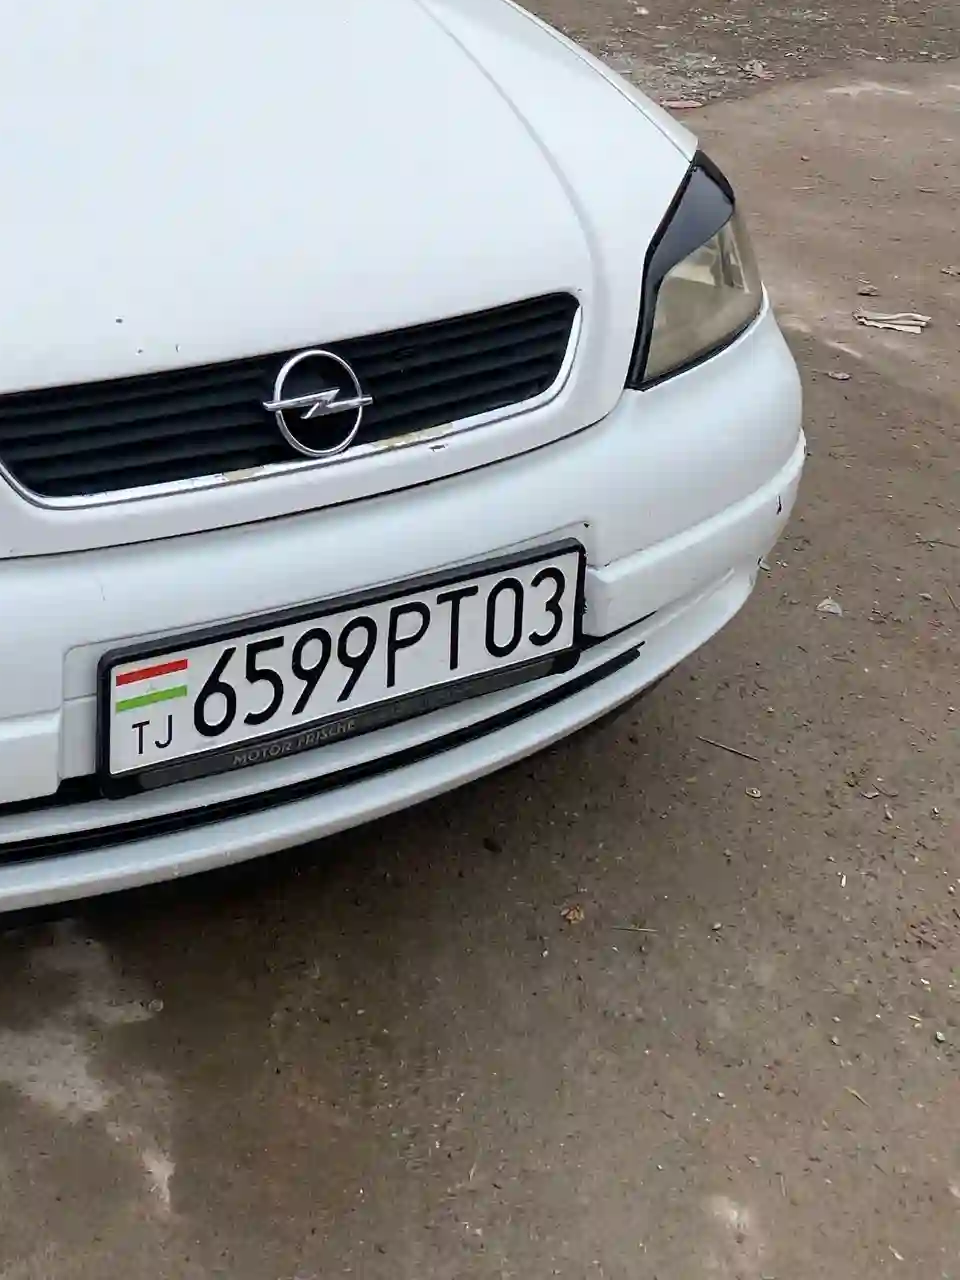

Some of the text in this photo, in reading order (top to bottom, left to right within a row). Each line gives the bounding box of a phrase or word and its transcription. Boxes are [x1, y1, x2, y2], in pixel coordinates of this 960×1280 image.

[193, 566, 566, 737] 6599PT03
[132, 714, 173, 755] TJ
[232, 741, 293, 765] MOTOR
